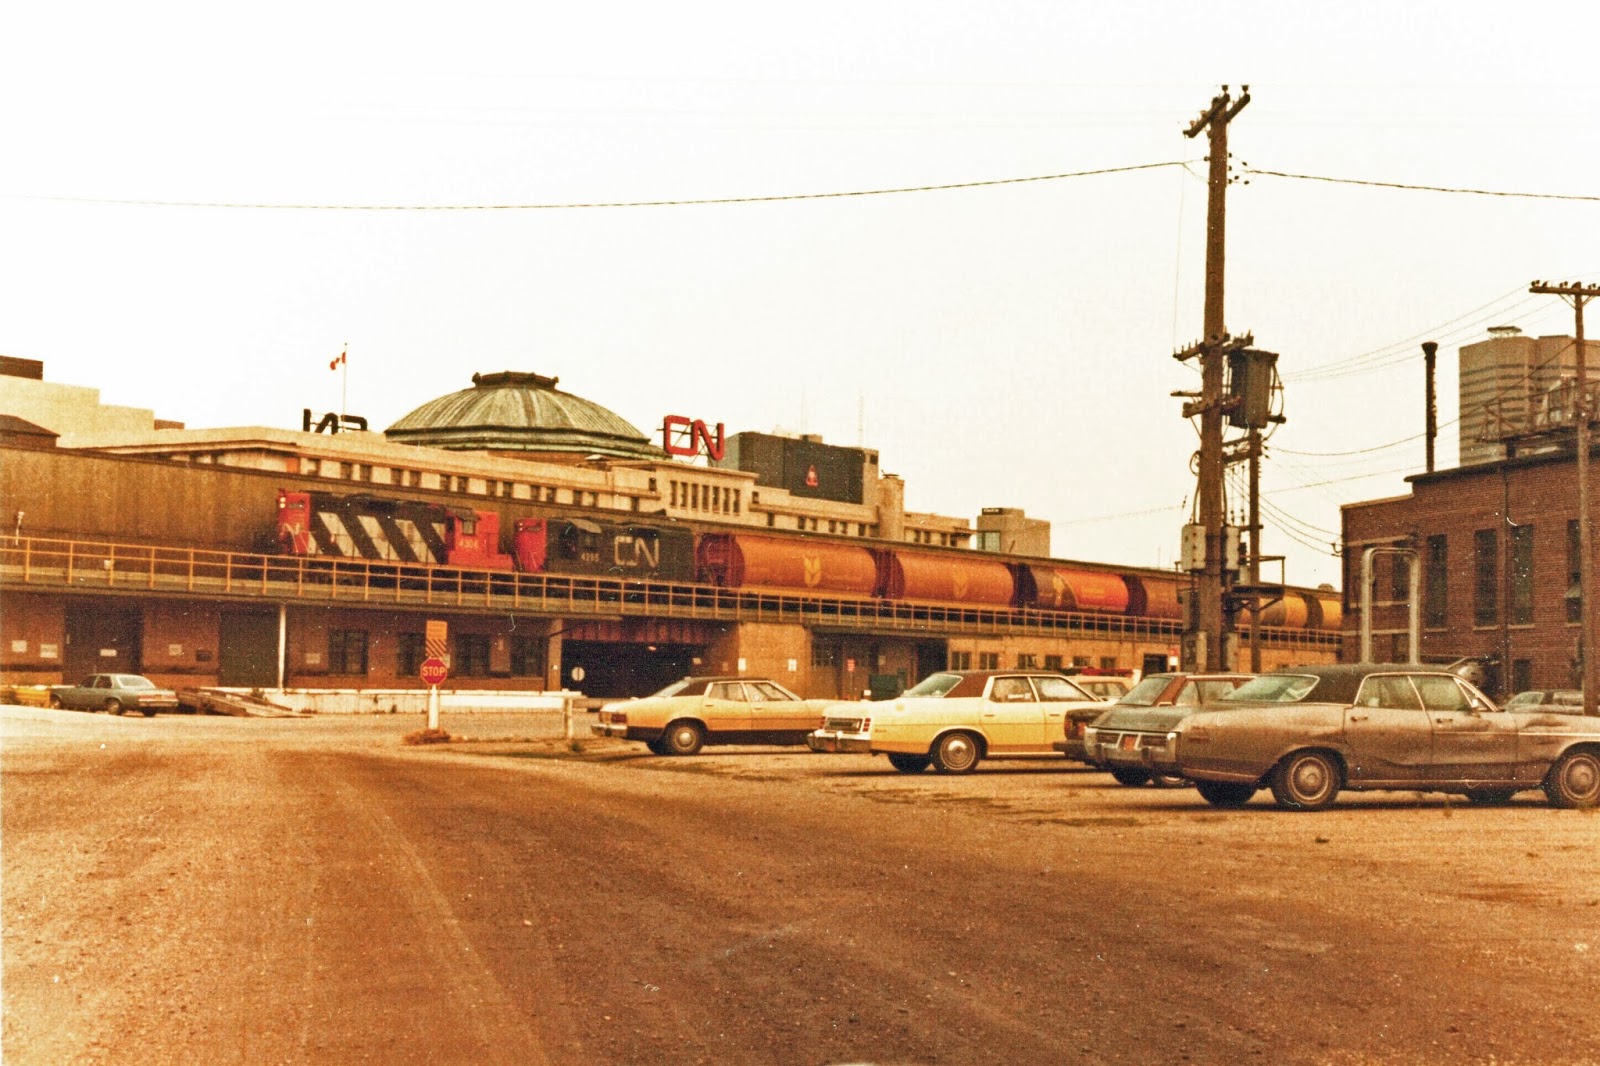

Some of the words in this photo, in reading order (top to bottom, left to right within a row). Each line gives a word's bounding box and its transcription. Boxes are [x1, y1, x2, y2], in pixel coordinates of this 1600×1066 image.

[663, 415, 724, 461] CN
[614, 535, 660, 568] CN
[422, 666, 446, 676] STOP
